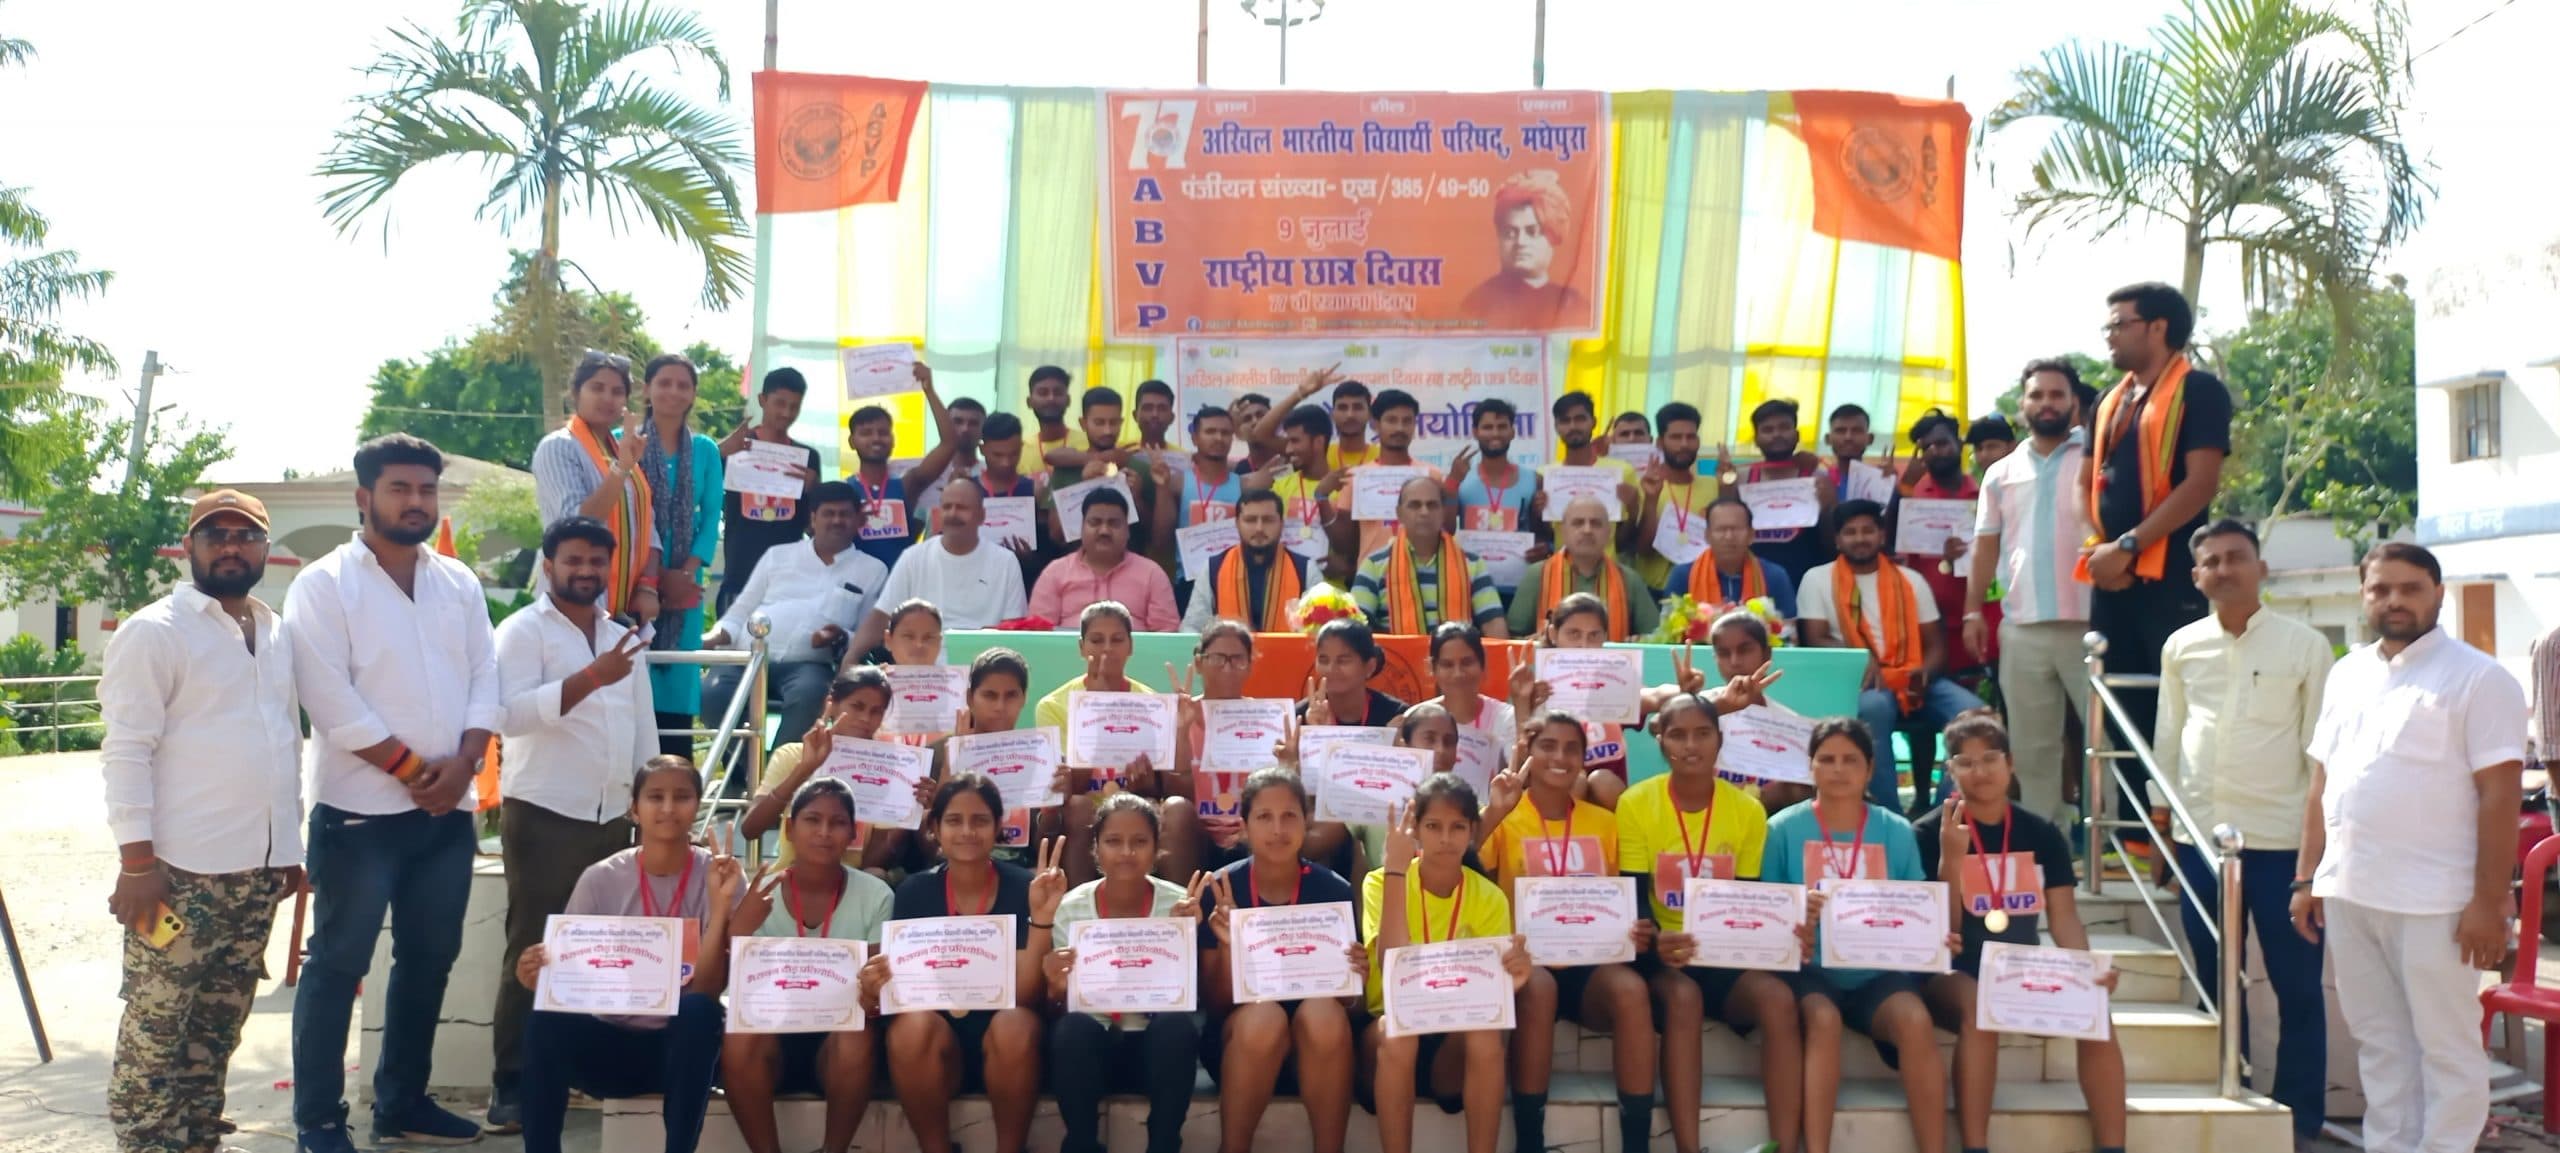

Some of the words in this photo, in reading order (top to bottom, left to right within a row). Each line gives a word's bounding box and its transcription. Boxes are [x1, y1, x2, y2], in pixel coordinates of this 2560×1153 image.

[1202, 120, 1272, 154] अखिल
[1282, 120, 1354, 154] भारतीय
[1363, 120, 1432, 154] विद्यार्थी
[1181, 172, 1255, 199] पंजीयन
[1278, 216, 1294, 241] 9
[1301, 207, 1372, 250] जुलाई
[1203, 251, 1295, 293] राष्ट्रीय
[1302, 256, 1358, 287] छात्र
[1364, 249, 1443, 287] दिवस
[1540, 840, 1585, 873] 30
